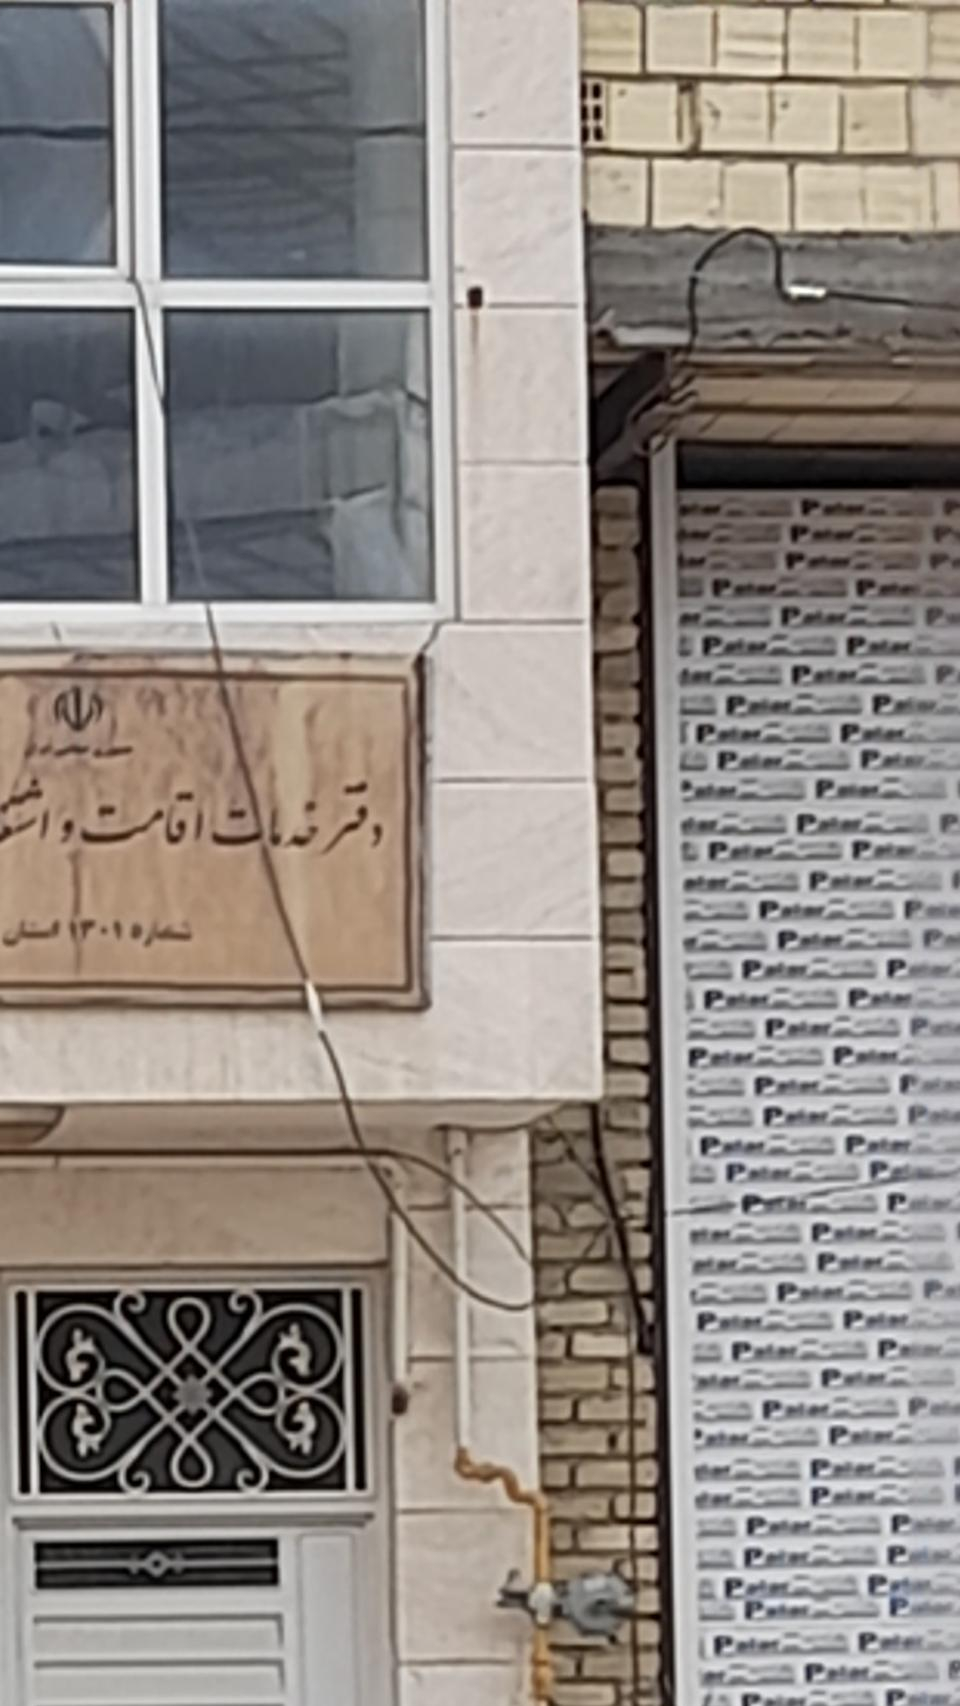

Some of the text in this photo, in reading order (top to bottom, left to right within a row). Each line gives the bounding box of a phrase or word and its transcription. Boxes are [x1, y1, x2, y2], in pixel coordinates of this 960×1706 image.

[60, 818, 76, 844] و
[81, 791, 203, 844] اقامت
[212, 801, 318, 847] خدمات
[322, 781, 384, 856] دفتر
[3, 919, 59, 946] استان
[131, 920, 192, 947] شماره
